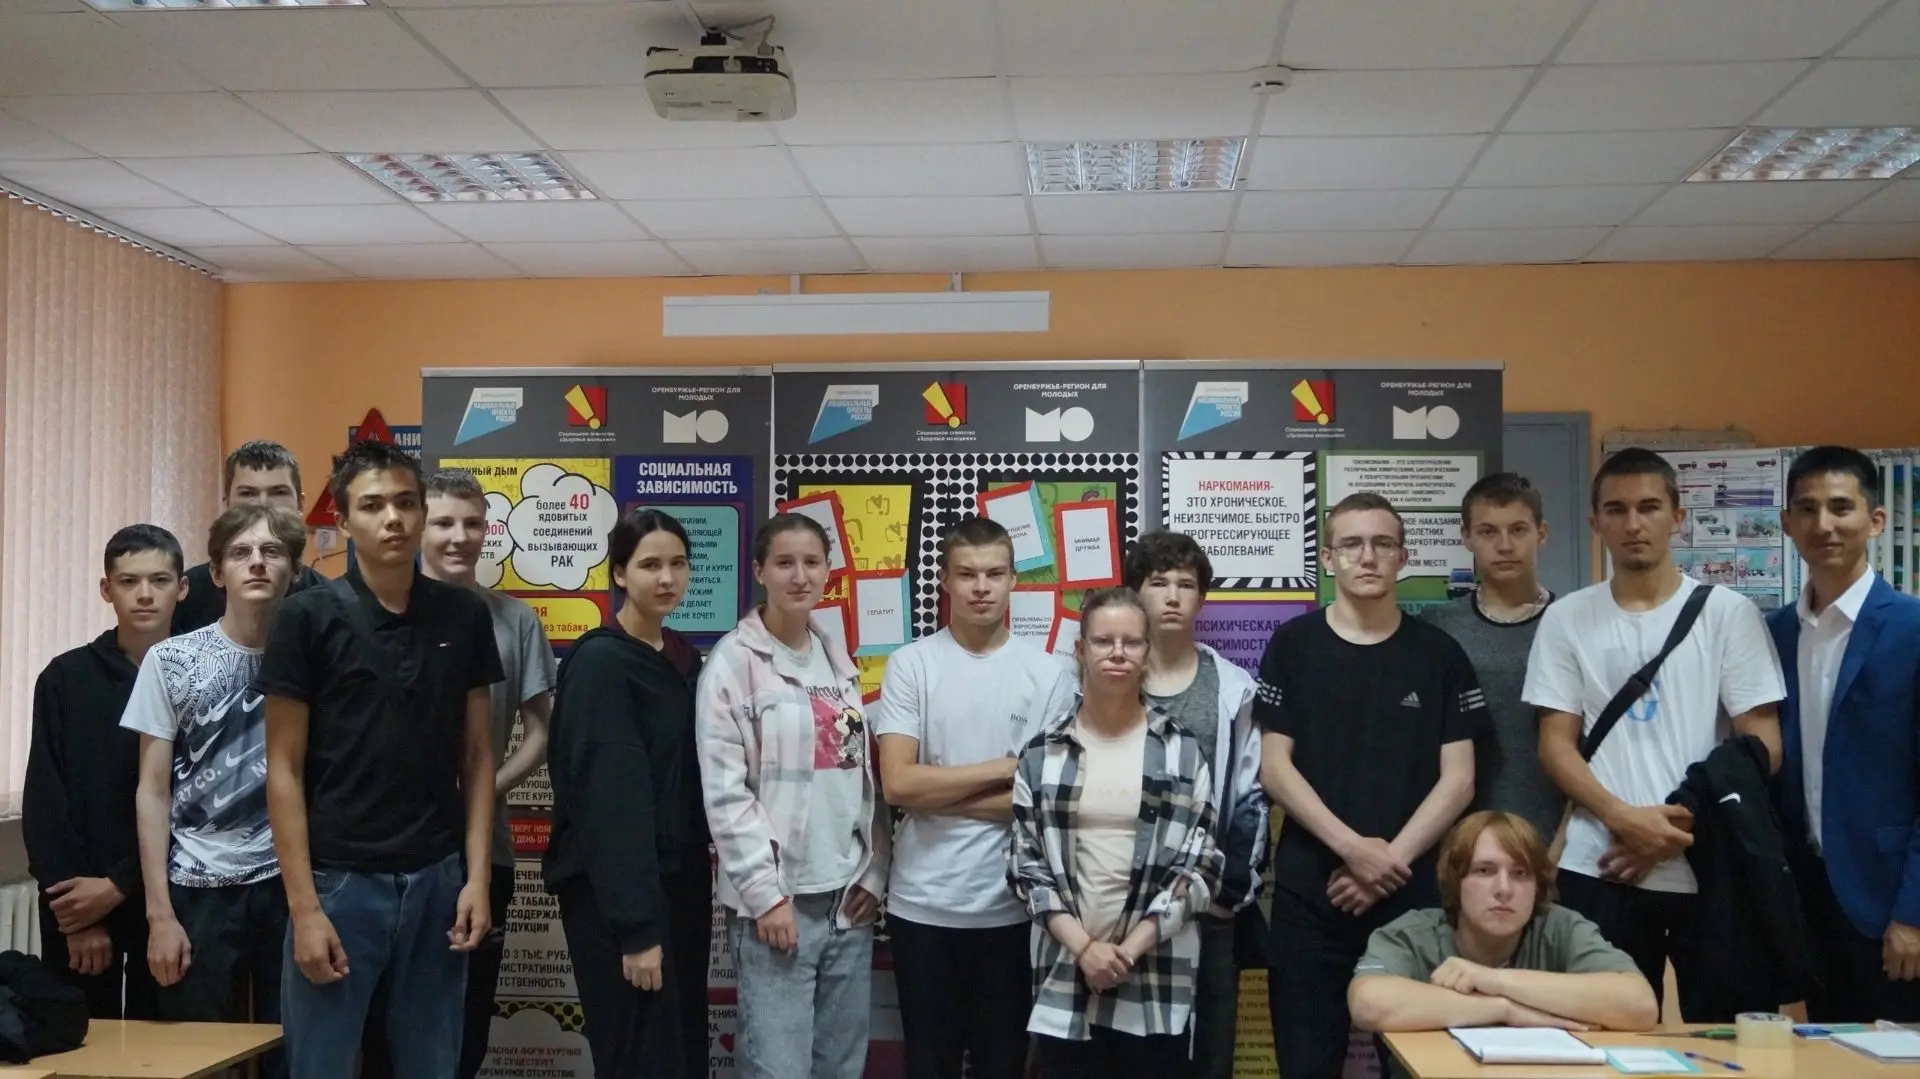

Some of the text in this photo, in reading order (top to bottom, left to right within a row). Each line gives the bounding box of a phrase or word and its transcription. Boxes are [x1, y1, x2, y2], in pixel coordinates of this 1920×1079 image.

[726, 387, 741, 395] ДЛЯ
[1092, 383, 1107, 391] ДЛЯ
[678, 394, 714, 402] МОЛОДЫХ
[461, 465, 518, 477] ЧНЫЙ ДЫМ
[639, 462, 732, 478] СОЦИАЛЬНАЯ
[636, 480, 738, 494] ЗАВИСИМОСТЬ
[1198, 480, 1275, 491] НАРКОМАНИЯ-
[536, 493, 589, 510] более 40
[1186, 496, 1207, 508] ЭТО
[538, 513, 588, 522] ядовитых
[1255, 513, 1300, 524] БЫСТРО
[533, 526, 593, 538] соединений
[687, 528, 722, 538] БЛЯЮЩЕЙ
[1183, 529, 1291, 542] ПРОГРЕССИРУЮЩЕЕ
[527, 542, 598, 552] вызывающих
[1075, 544, 1100, 552] ДРУЖБА
[551, 555, 574, 568] РАК
[1423, 559, 1448, 567] МЕСТЕ
[712, 564, 735, 572] КУРИТ
[686, 600, 712, 608] ДЕЛАЕТ
[866, 608, 894, 616] ГЕПАТИТ
[556, 622, 589, 632] табака
[194, 768, 222, 789] CO.
[521, 896, 556, 906] ТАБАКА
[513, 950, 519, 959] 3
